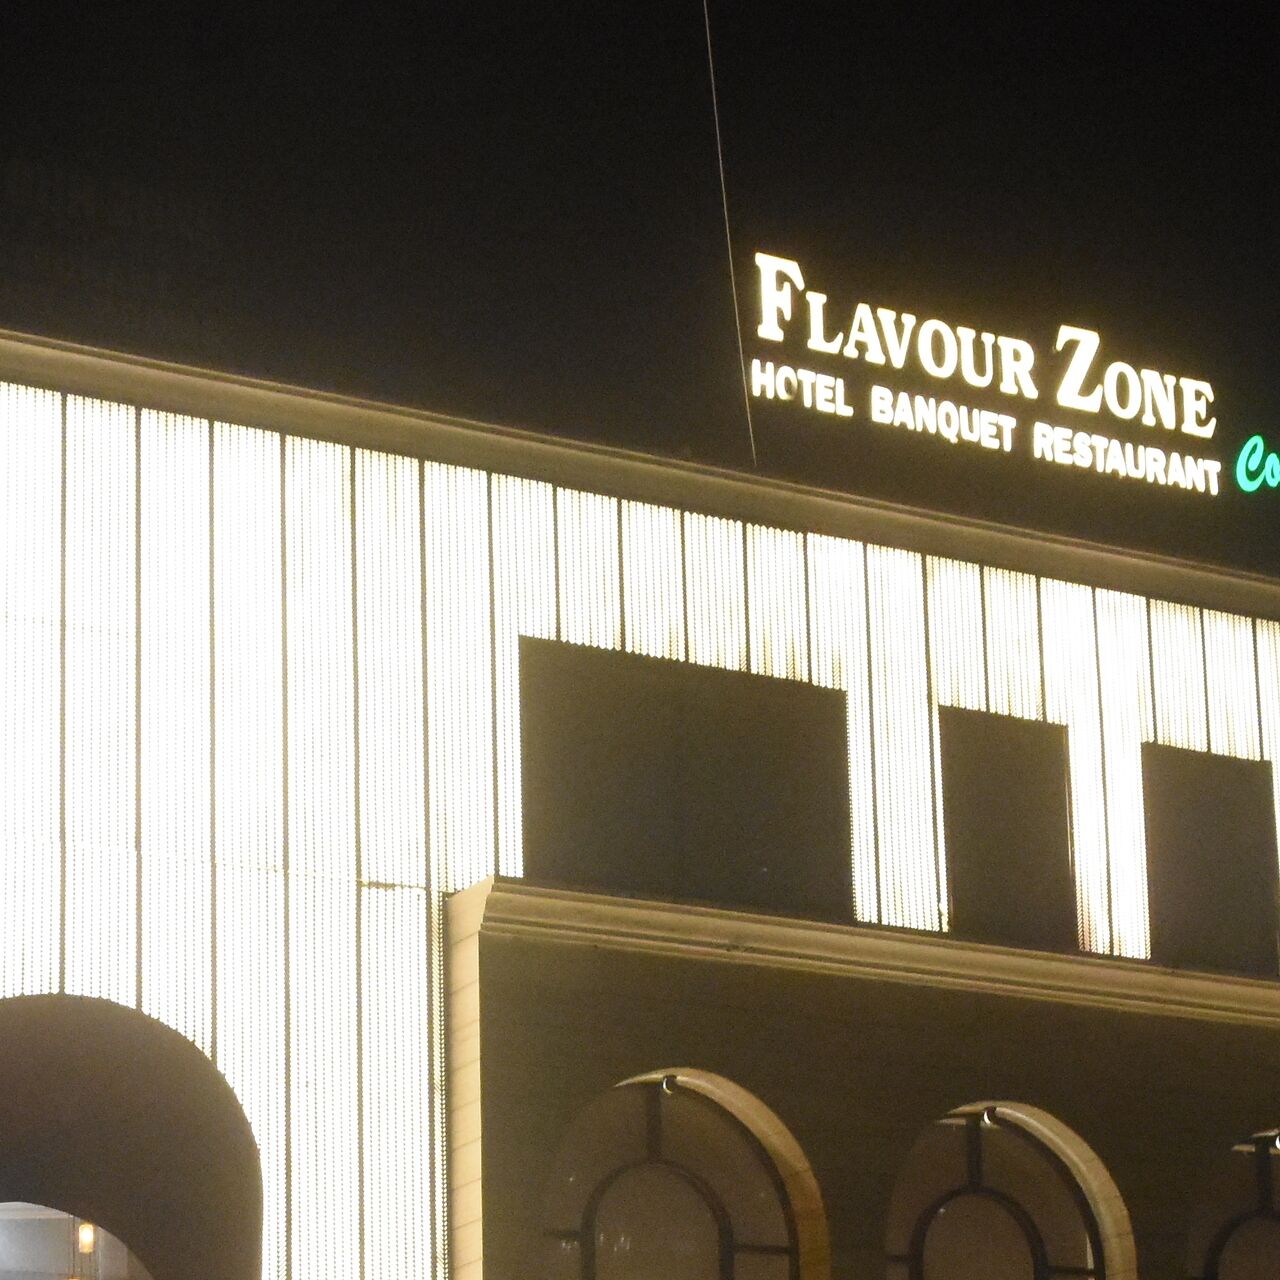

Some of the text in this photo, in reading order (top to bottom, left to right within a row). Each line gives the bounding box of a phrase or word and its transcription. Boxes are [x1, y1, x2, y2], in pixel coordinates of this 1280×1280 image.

[754, 251, 1218, 439] FLAVOUR ZONE
[750, 358, 1222, 496] HOTEL BANQUET RESTAURANT
